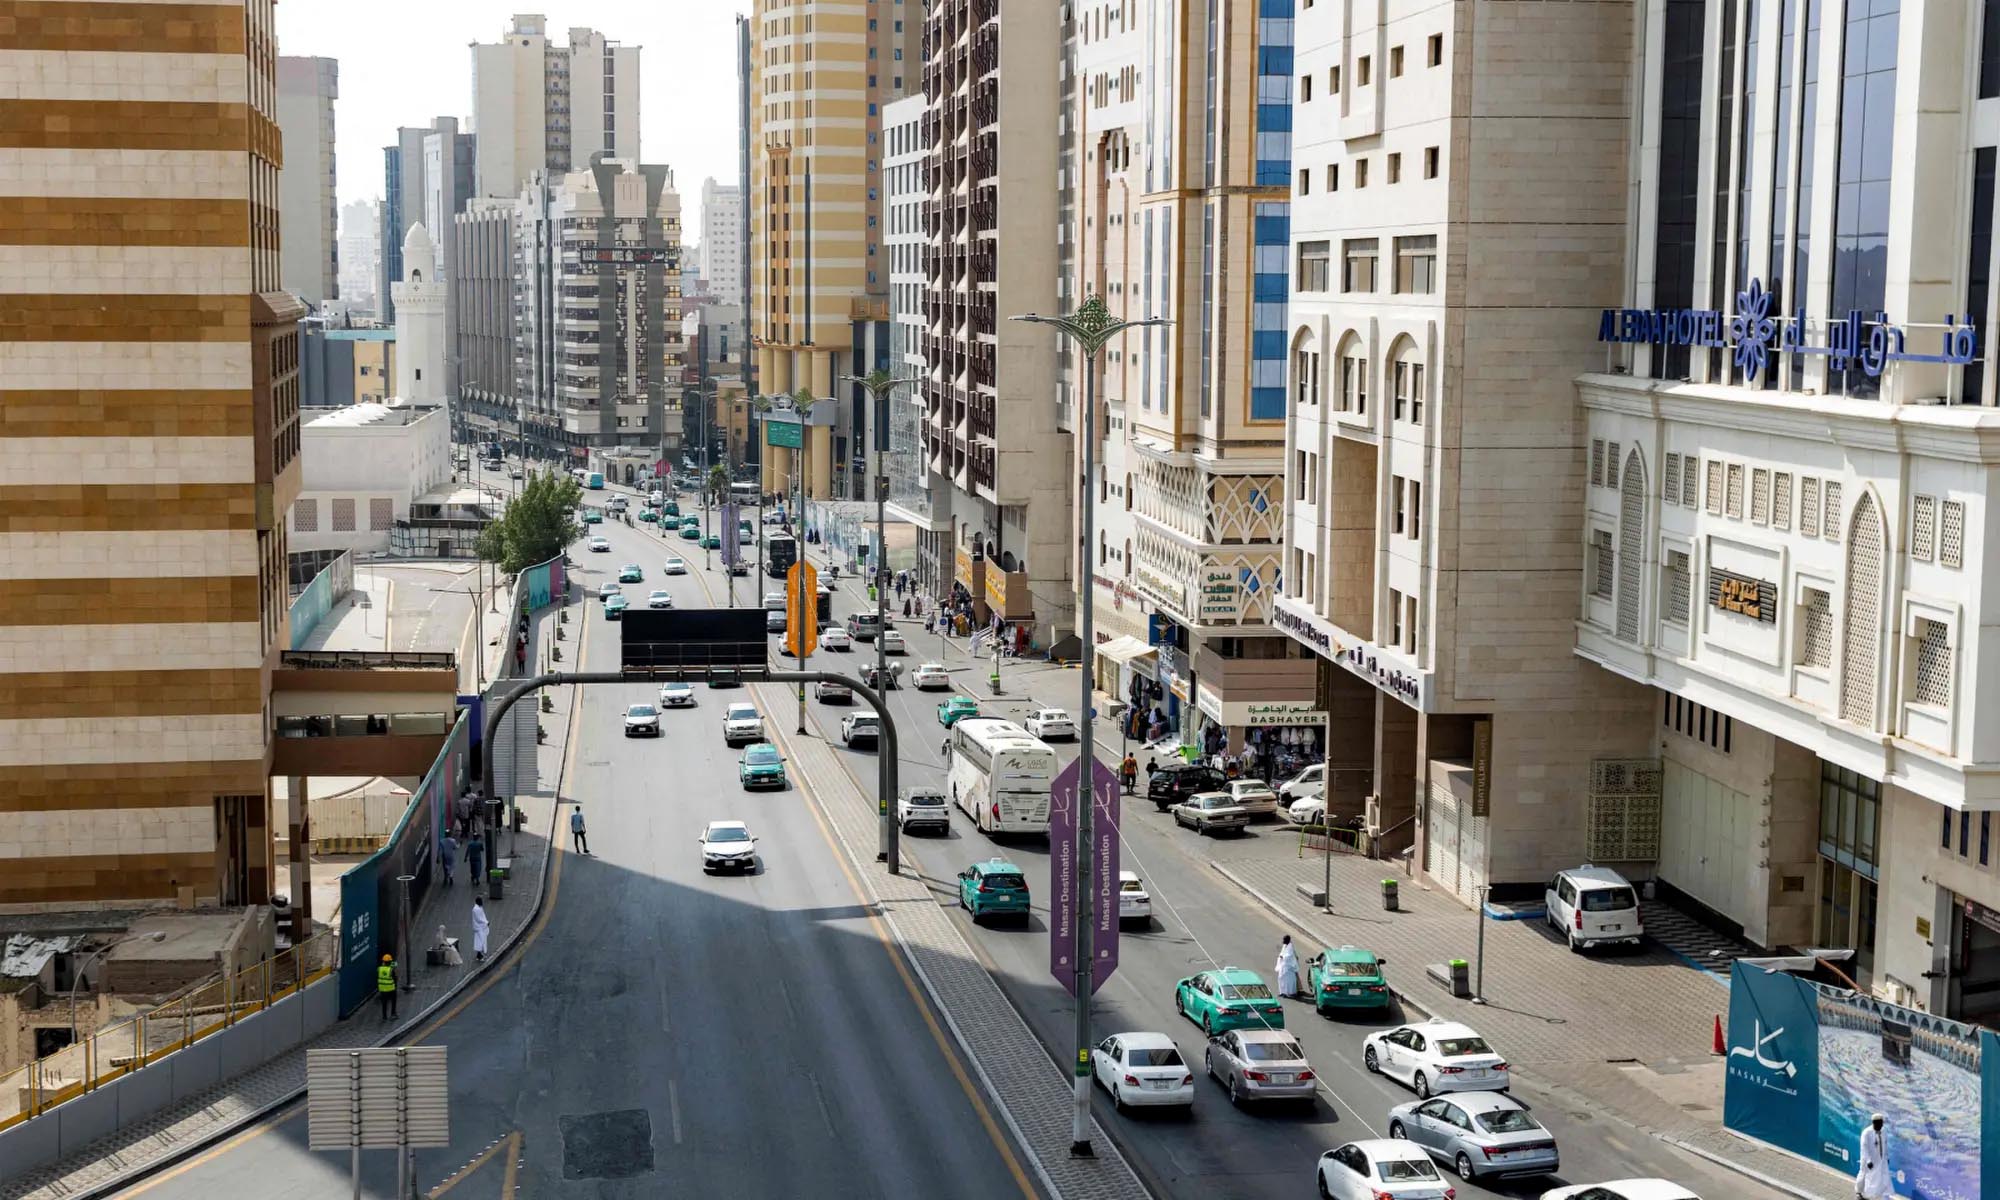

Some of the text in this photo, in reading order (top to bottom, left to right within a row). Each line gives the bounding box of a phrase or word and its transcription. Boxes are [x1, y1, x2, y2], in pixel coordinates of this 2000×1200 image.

[1665, 308, 1726, 348] HOTEL
[1863, 310, 1977, 376] فندق
[1207, 572, 1232, 582] فندق
[1248, 705, 1287, 714] الجاهزة
[1250, 715, 1318, 723] BASHAYER
[1060, 840, 1070, 937] Masar Destination
[1100, 834, 1110, 931] Masar Destination
[1729, 1066, 1761, 1084] MASAR
